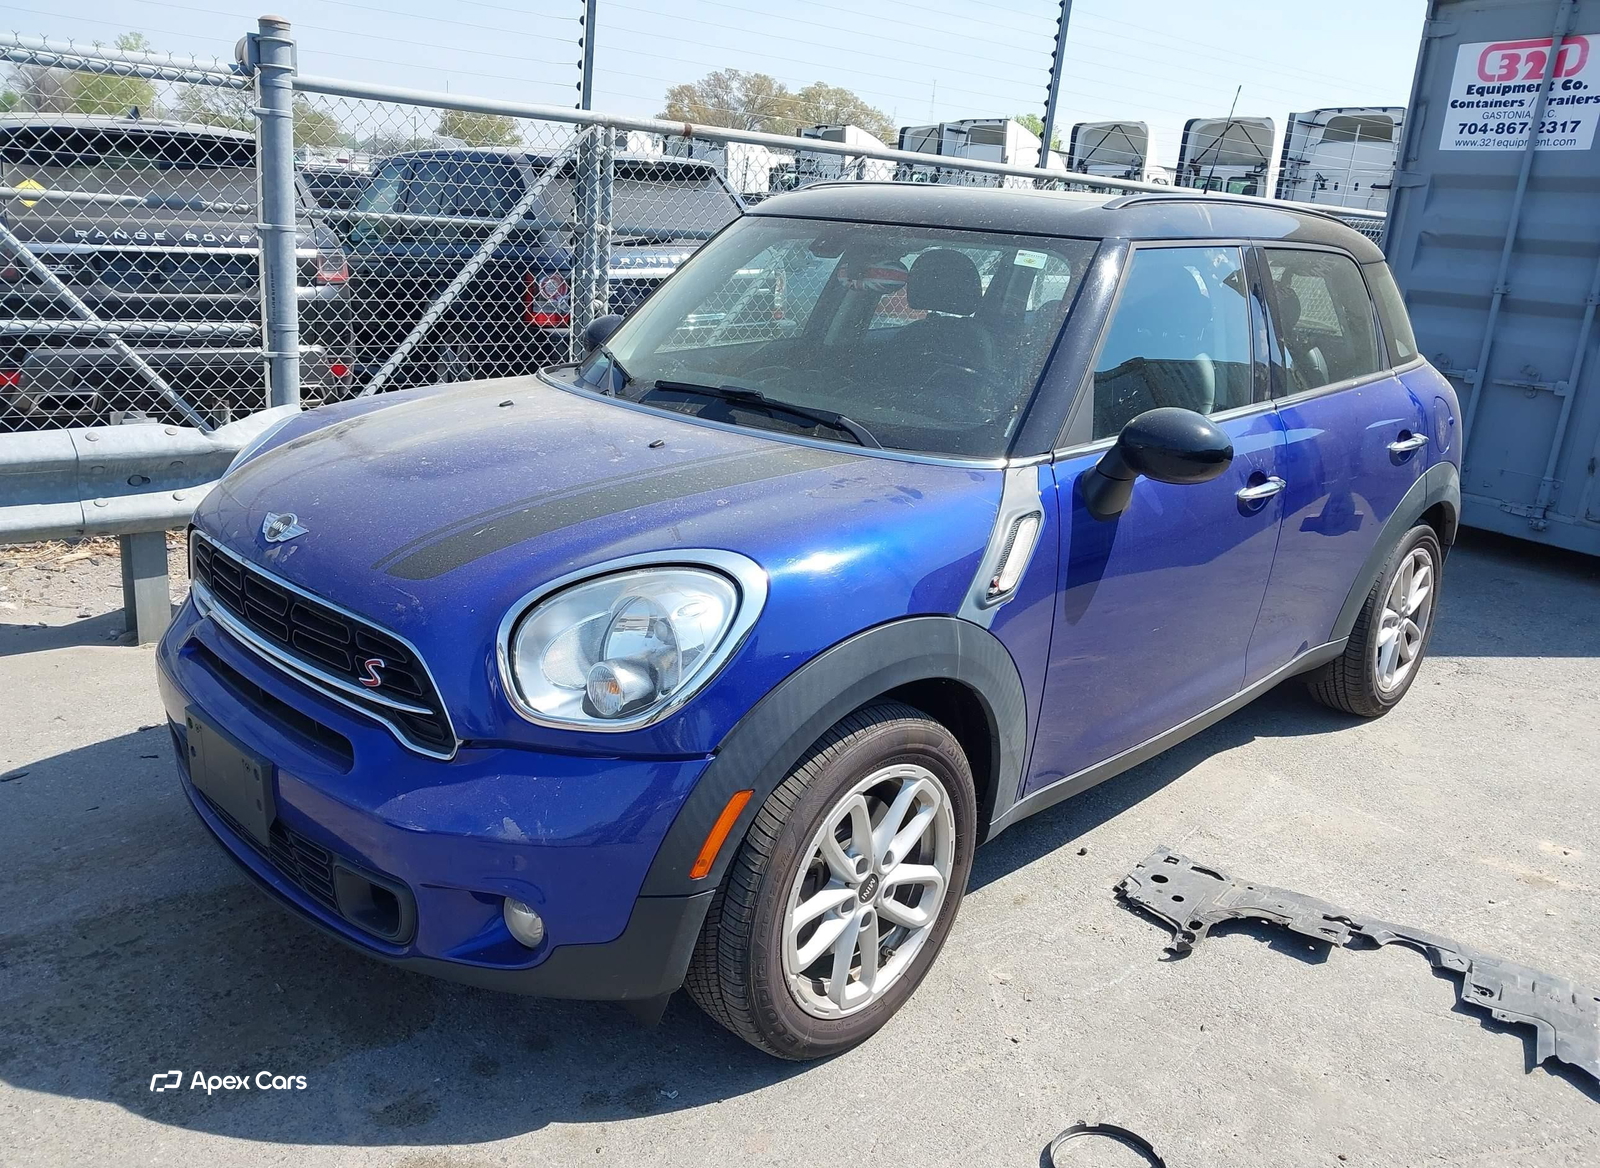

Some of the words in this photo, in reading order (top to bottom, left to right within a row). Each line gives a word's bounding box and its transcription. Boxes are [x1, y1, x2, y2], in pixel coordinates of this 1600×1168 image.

[1496, 47, 1569, 82] 321
[1561, 79, 1588, 91] Co.
[1450, 99, 1525, 109] Containers
[1528, 96, 1536, 108] /
[1546, 94, 1600, 106] railers
[1482, 110, 1533, 120] GASTONIA,
[1458, 120, 1582, 135] 704-867-2317
[74, 229, 166, 241] RANGE
[185, 233, 259, 243] ROVE
[272, 520, 288, 533] MINI
[358, 658, 385, 687] S
[861, 877, 876, 900] MINI
